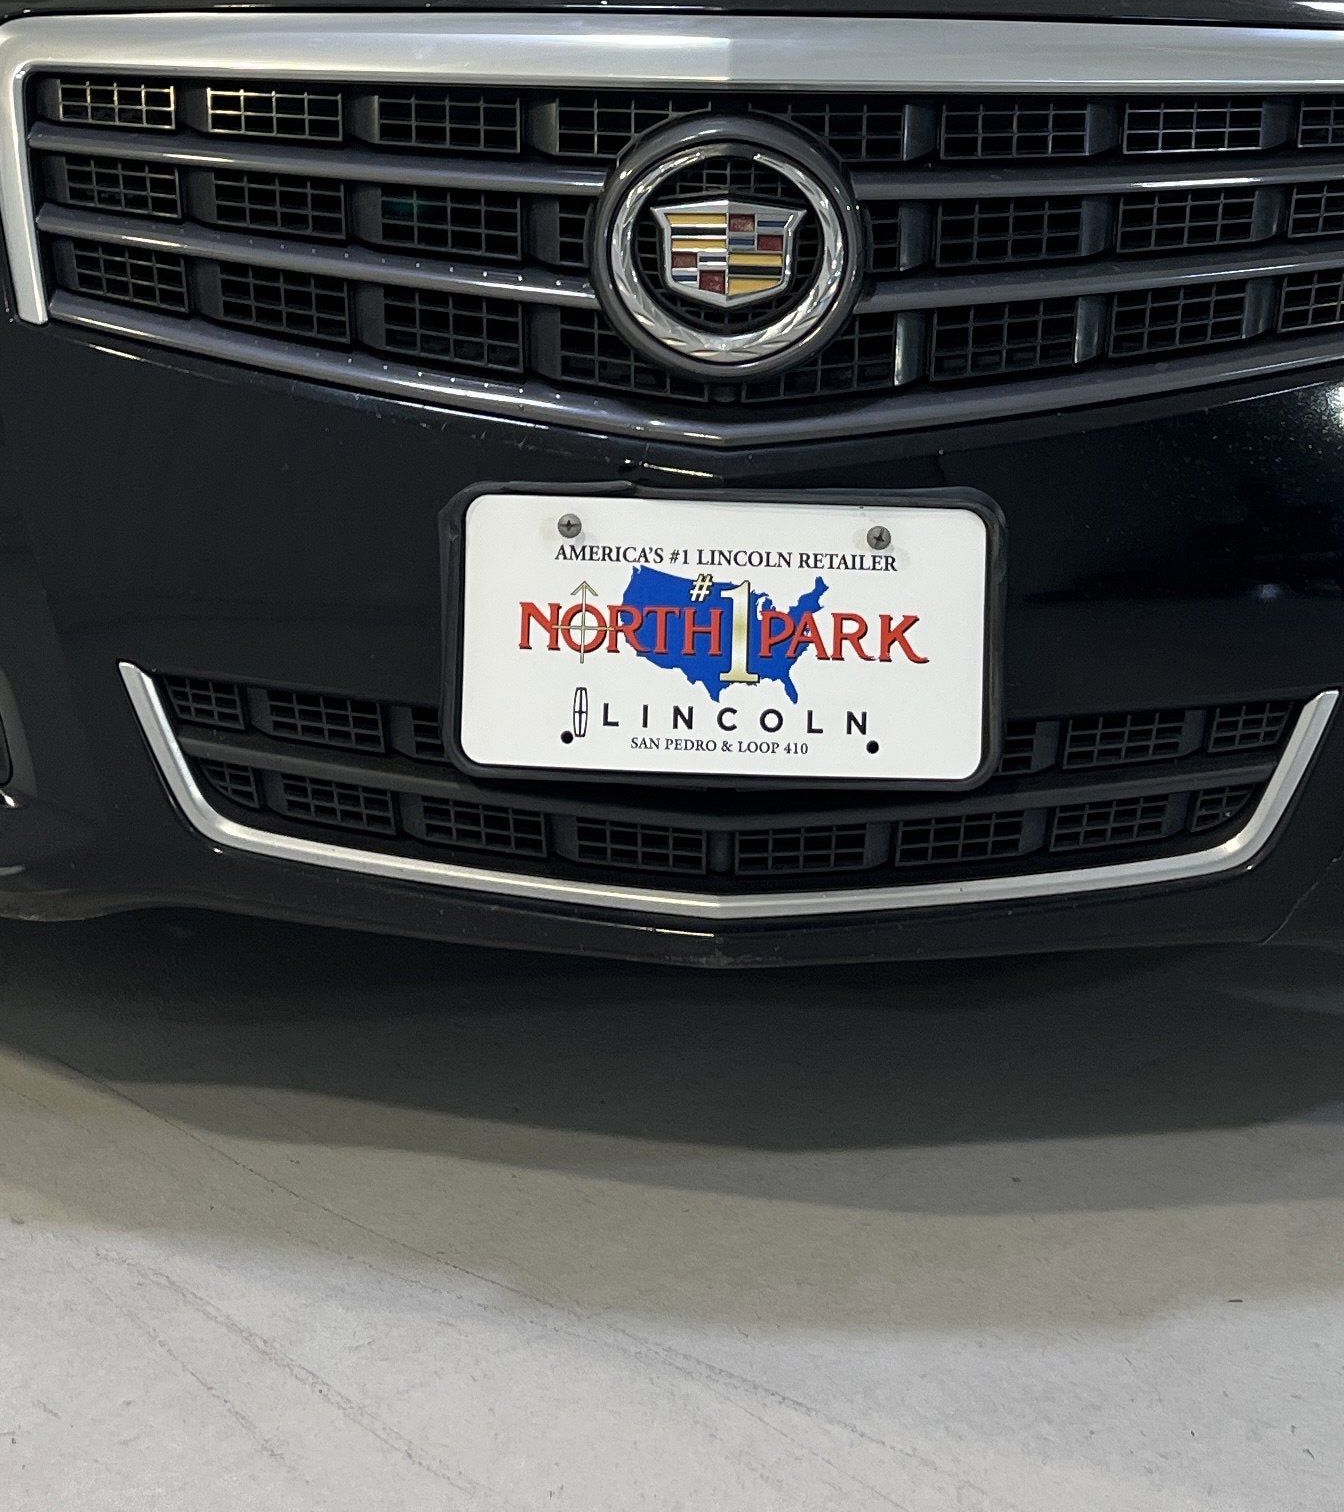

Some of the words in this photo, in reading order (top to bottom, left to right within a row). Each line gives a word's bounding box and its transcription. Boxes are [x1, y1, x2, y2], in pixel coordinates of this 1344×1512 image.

[554, 544, 664, 564] AMERICA'S
[668, 548, 690, 565] #1
[696, 548, 793, 569] LINCOLN
[797, 552, 898, 572] RETAILER
[519, 601, 723, 657] NORTH
[760, 610, 930, 664] PARK
[602, 702, 867, 736] LINCOLN
[630, 737, 661, 750] SAN
[664, 738, 717, 752] PEDRO
[720, 740, 733, 753] &
[737, 740, 780, 754] LOOP
[783, 742, 809, 755] 410
